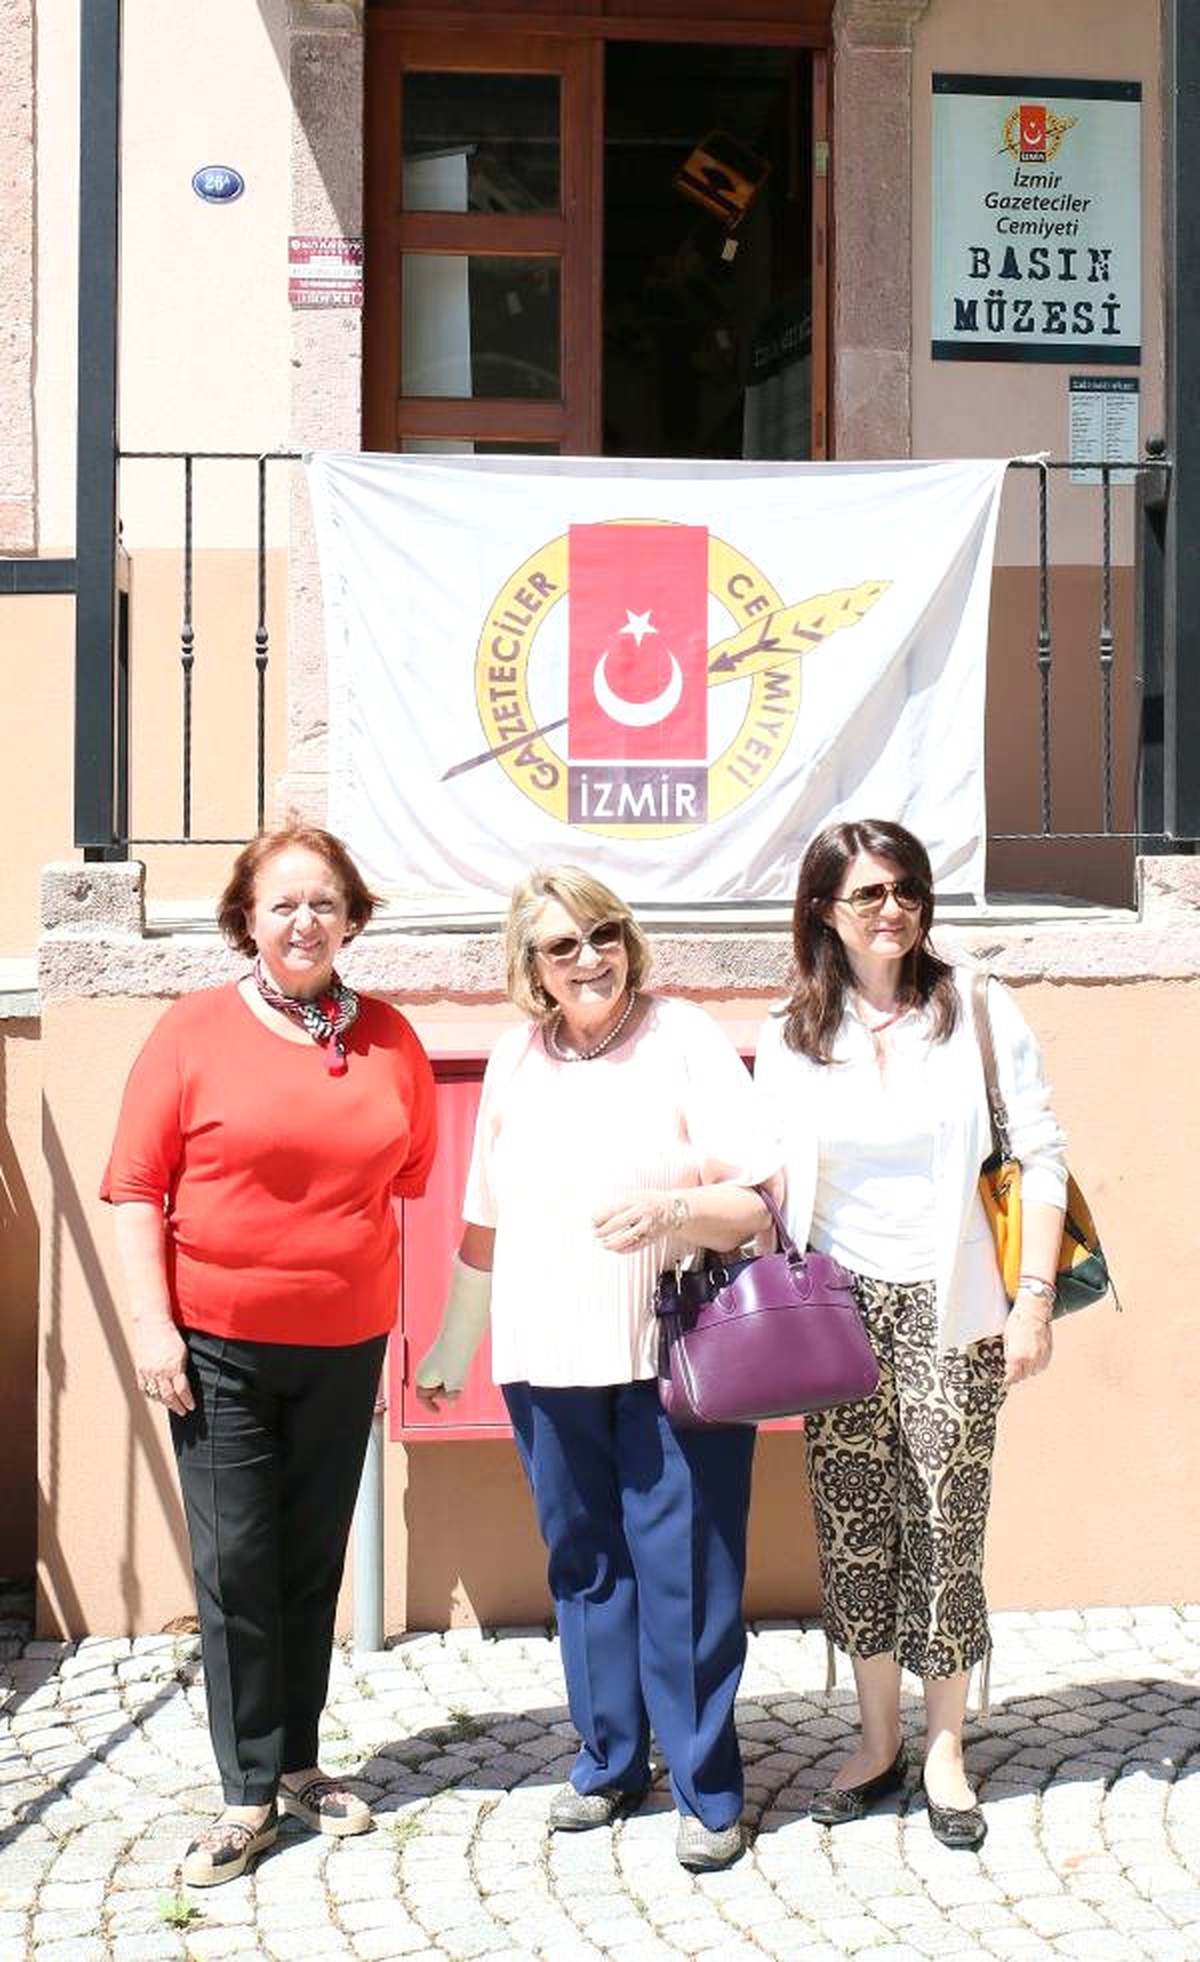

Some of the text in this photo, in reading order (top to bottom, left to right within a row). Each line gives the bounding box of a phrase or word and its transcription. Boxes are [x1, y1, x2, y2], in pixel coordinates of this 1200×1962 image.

[1013, 167, 1062, 189] İzmir
[984, 191, 1092, 213] Gazeteciler
[996, 216, 1080, 239] Cemiyeti
[967, 245, 1113, 283] BASIN
[953, 289, 1122, 335] MÜZESİ
[488, 571, 560, 790] GAZETECİLER
[580, 773, 698, 818] İZMİR
